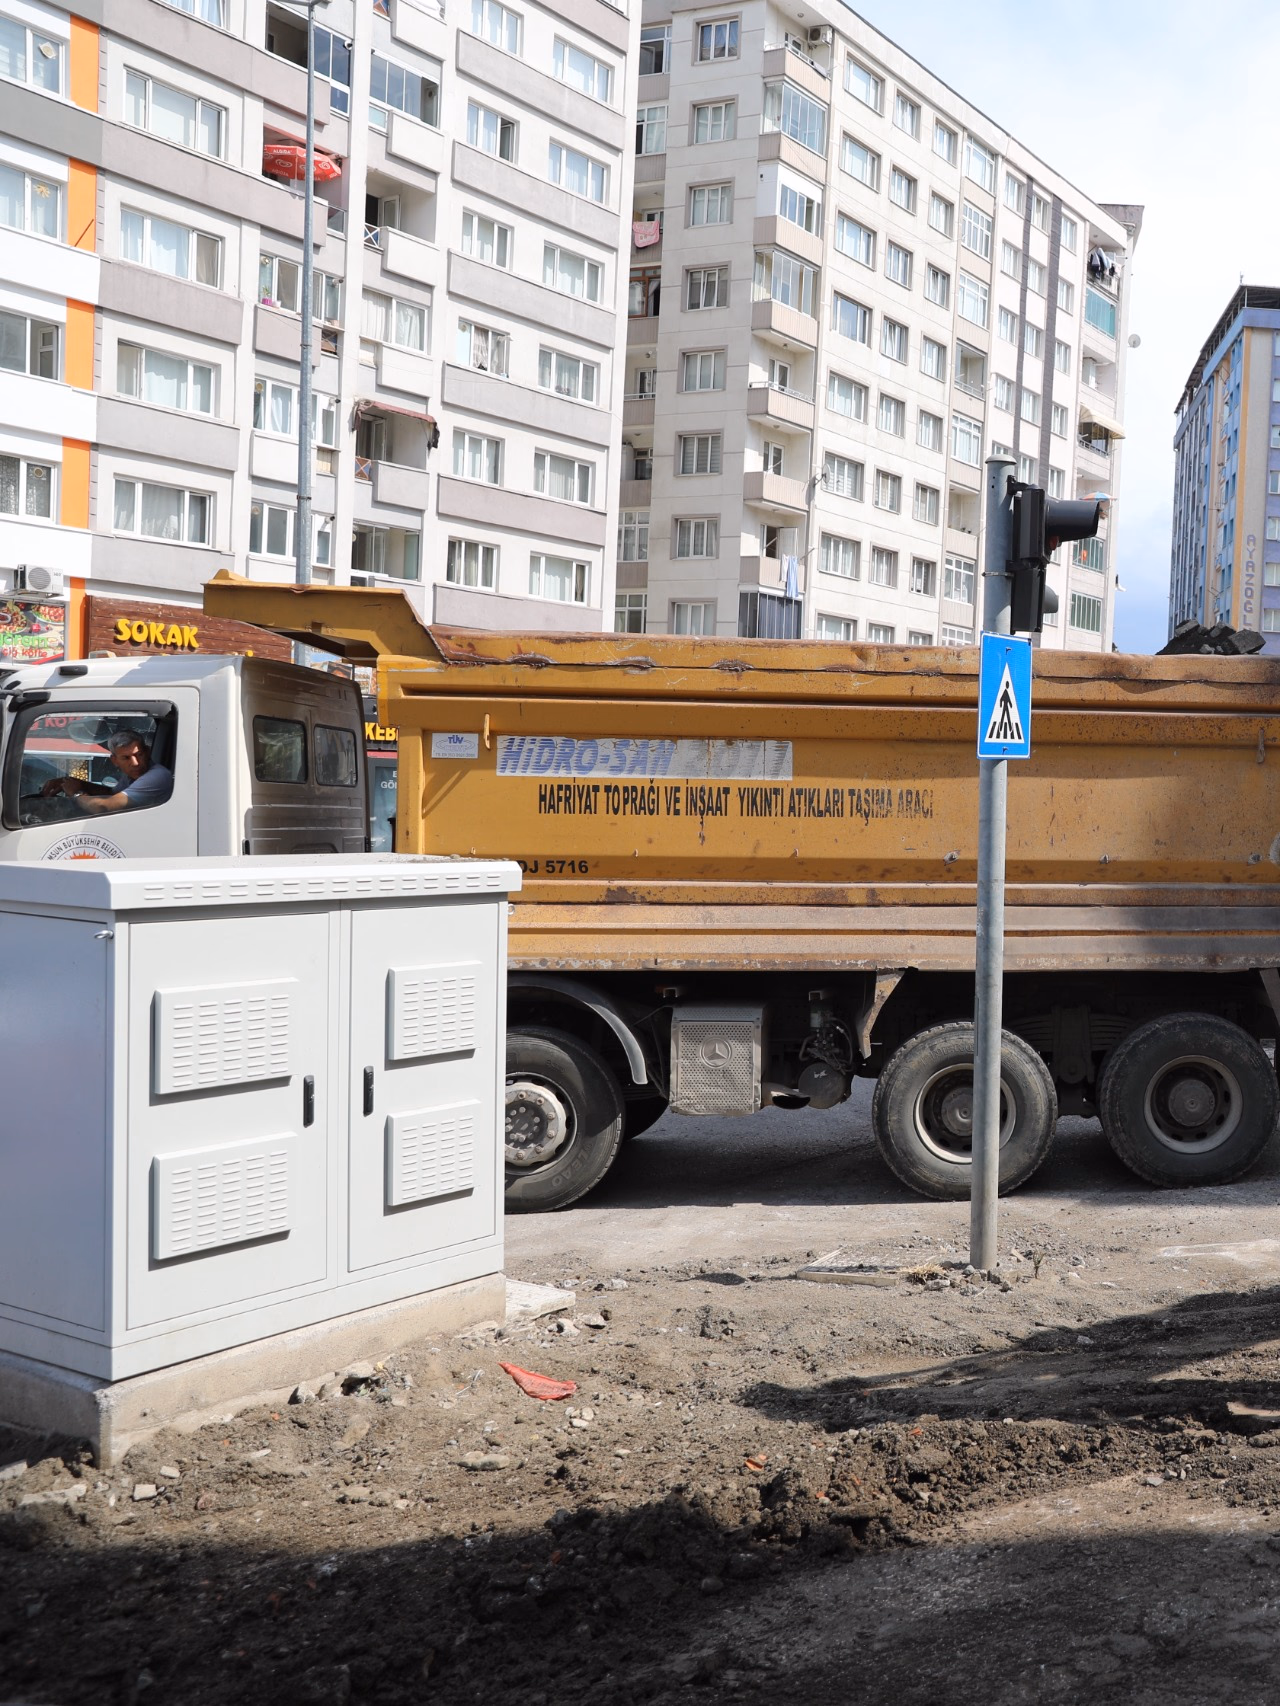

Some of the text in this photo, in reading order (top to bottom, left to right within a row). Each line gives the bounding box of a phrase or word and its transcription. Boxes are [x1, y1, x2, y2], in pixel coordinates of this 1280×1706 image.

[116, 619, 199, 648] SOKAK
[365, 721, 399, 742] KEB
[448, 734, 464, 744] TÜV
[538, 777, 600, 815] HAFRİYAT
[664, 786, 681, 816] VE
[685, 779, 731, 826] İNŞAAT
[738, 787, 784, 818] YIKINTI
[788, 788, 844, 819] ATIKLARI
[848, 788, 893, 827] TAŞIMA
[897, 789, 934, 819] ARACI
[47, 845, 62, 860] MSUN
[545, 860, 589, 873] 5716
